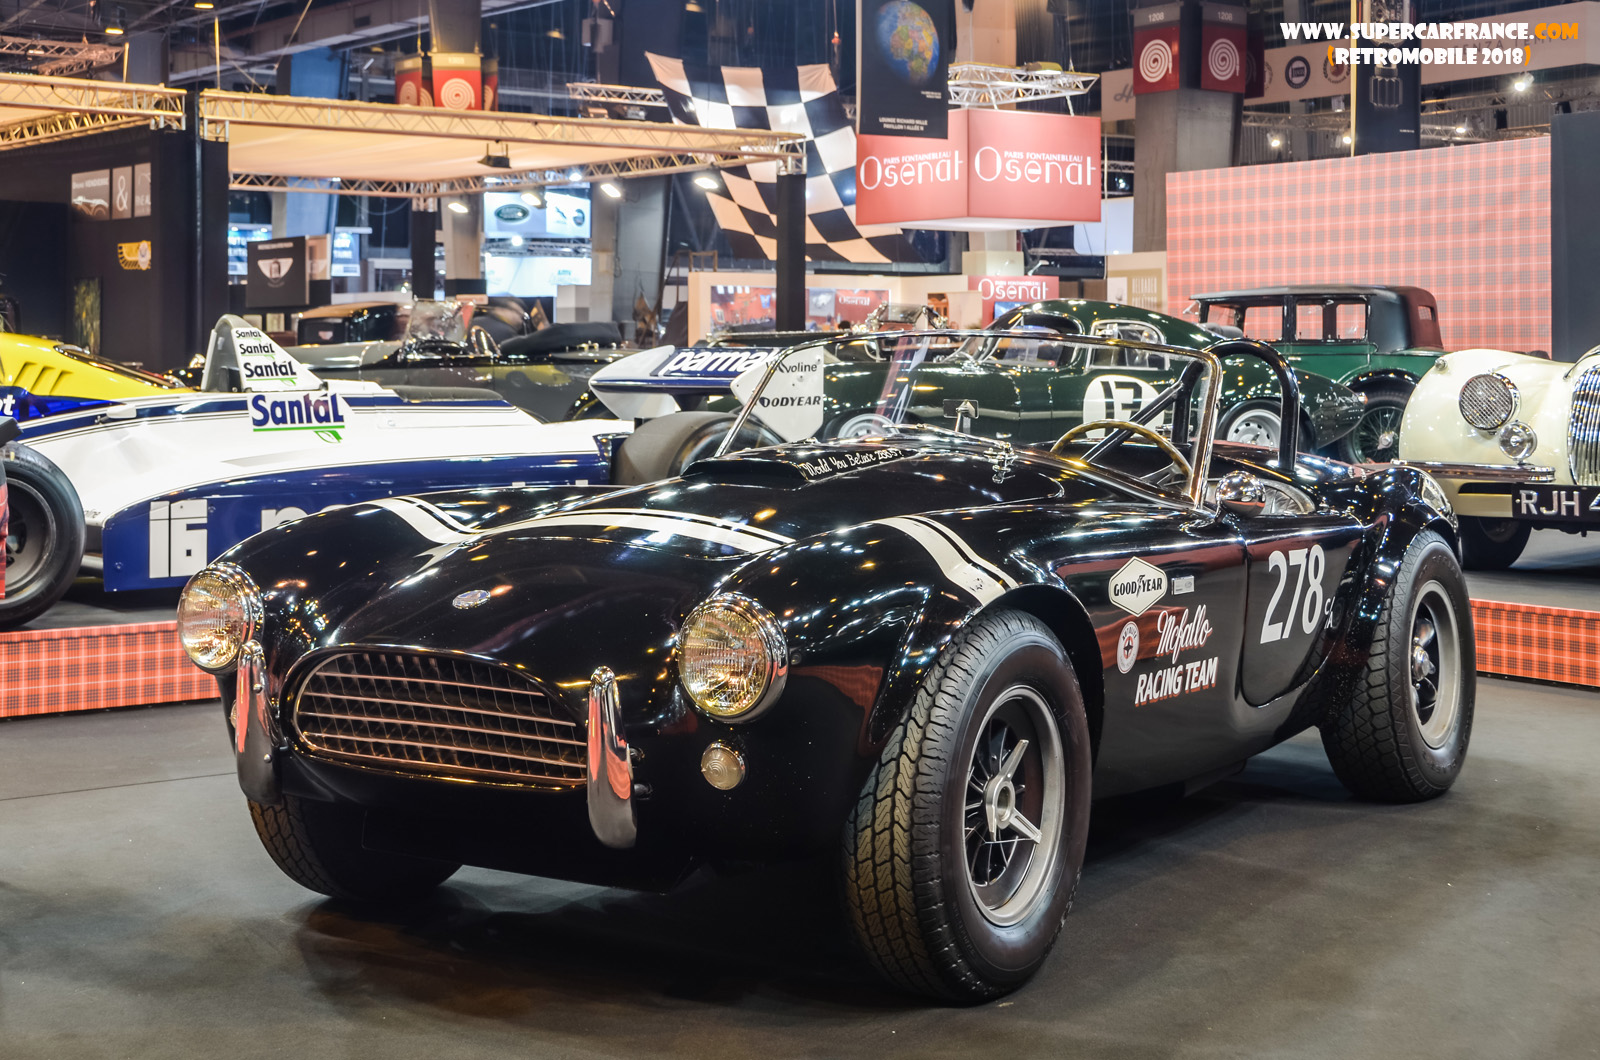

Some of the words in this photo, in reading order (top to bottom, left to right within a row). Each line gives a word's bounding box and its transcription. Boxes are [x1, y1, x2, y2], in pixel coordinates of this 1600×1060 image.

[1148, 12, 1164, 22] 1208
[1217, 11, 1233, 21] 1208
[883, 156, 900, 165] PARIS
[902, 151, 952, 163] FONTAINEBLEAU
[974, 146, 1096, 186] Osenat
[1004, 151, 1024, 159] PARIS
[1026, 152, 1083, 162] FONTAINEBLEAU
[860, 150, 964, 190] Osenat
[978, 278, 1049, 300] Osenat
[829, 456, 849, 470] You
[1519, 489, 1580, 517] RJH
[1260, 544, 1325, 644] 278
[1135, 664, 1184, 706] RACING
[1184, 656, 1219, 693] TEAM
